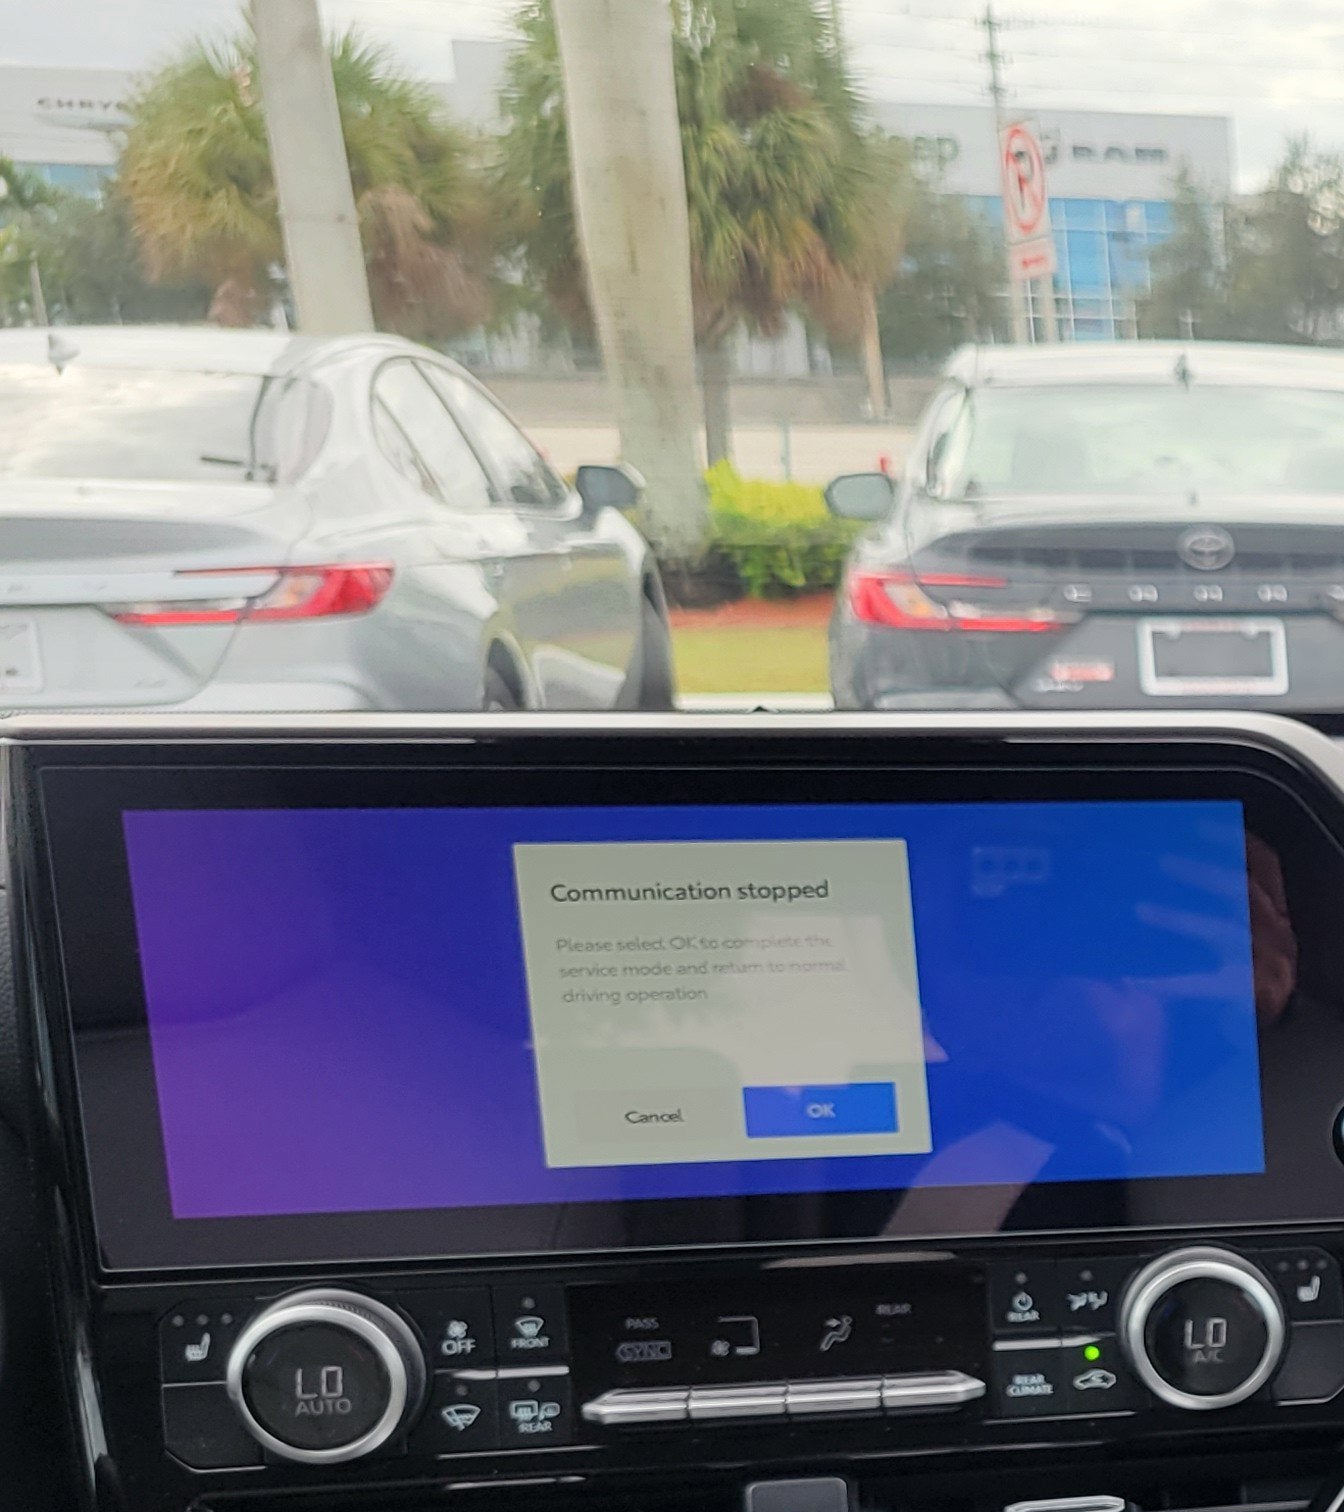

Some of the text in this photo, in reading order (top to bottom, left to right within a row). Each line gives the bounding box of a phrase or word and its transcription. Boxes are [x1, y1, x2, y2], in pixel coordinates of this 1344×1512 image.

[550, 880, 829, 904] Communication stopped
[556, 935, 833, 952] Please select OK to complete the
[559, 958, 847, 978] service mode and return to normal
[563, 987, 708, 1005] driving operation
[625, 1103, 836, 1124] Cancel OK
[626, 1317, 660, 1331] PASS
[1184, 1317, 1228, 1349] LO
[441, 1339, 476, 1356] OFF
[510, 1336, 550, 1349] FRONT
[1192, 1349, 1224, 1364] A/C
[295, 1366, 344, 1400] LO
[1006, 1383, 1055, 1398] CLIMATE
[295, 1399, 353, 1417] AUTO
[518, 1420, 553, 1434] REAR
